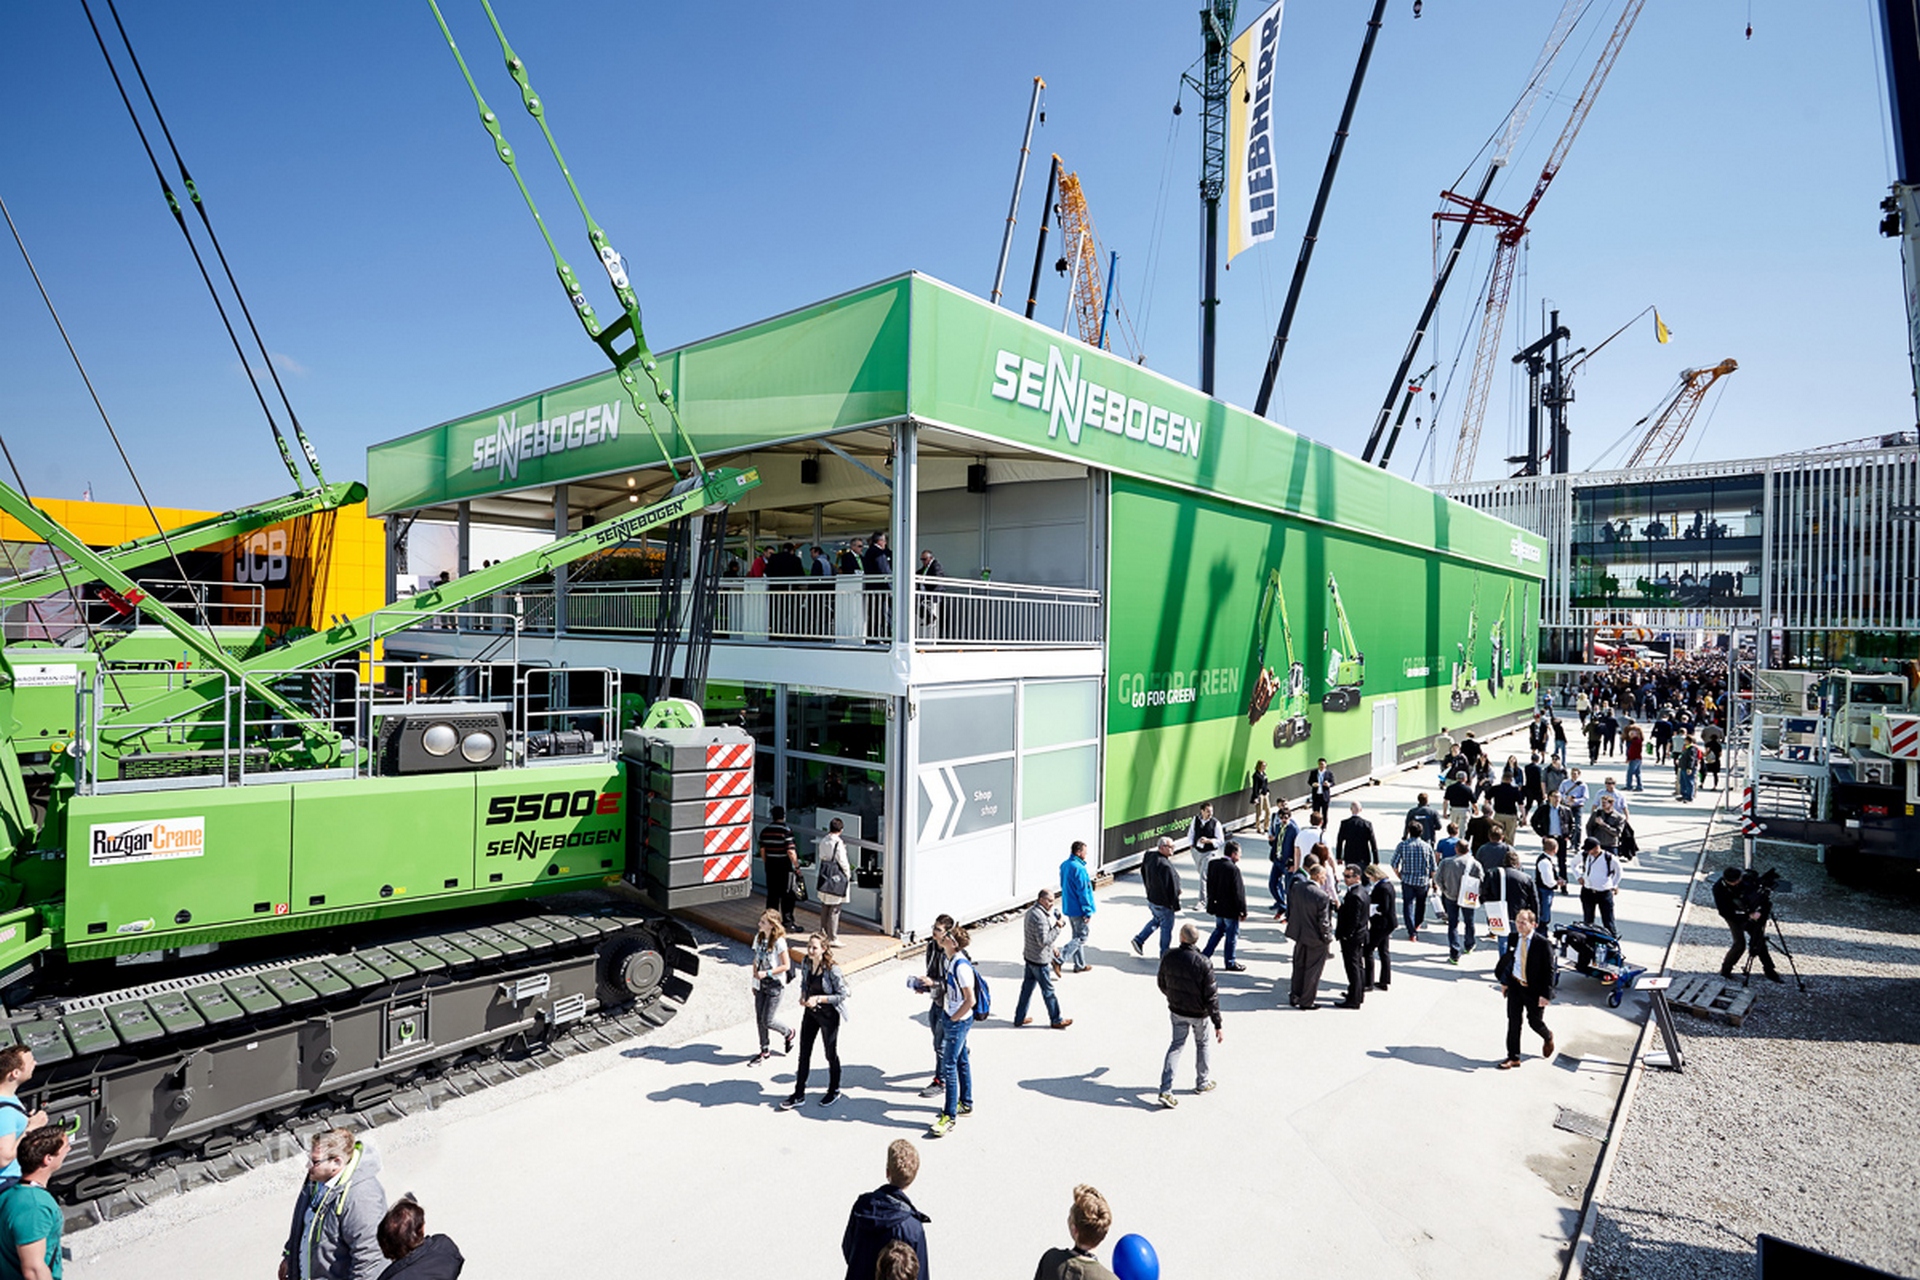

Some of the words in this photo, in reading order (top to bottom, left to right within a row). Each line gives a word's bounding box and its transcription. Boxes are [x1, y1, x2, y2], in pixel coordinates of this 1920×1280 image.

[1248, 7, 1281, 237] LIEBHERR
[991, 344, 1202, 458] SENNEBOGEN
[472, 400, 621, 481] SENNEBOGEN
[596, 501, 684, 543] SENNEBOGEN
[236, 529, 287, 583] JCB
[1118, 673, 1145, 704] GO
[1131, 691, 1146, 708] GO
[1146, 690, 1166, 706] FOR
[1166, 687, 1196, 703] GREEN
[485, 790, 623, 826] 5500E
[974, 790, 992, 801] Shop
[980, 804, 998, 816] shop
[486, 828, 622, 861] SENNEBOGEN
